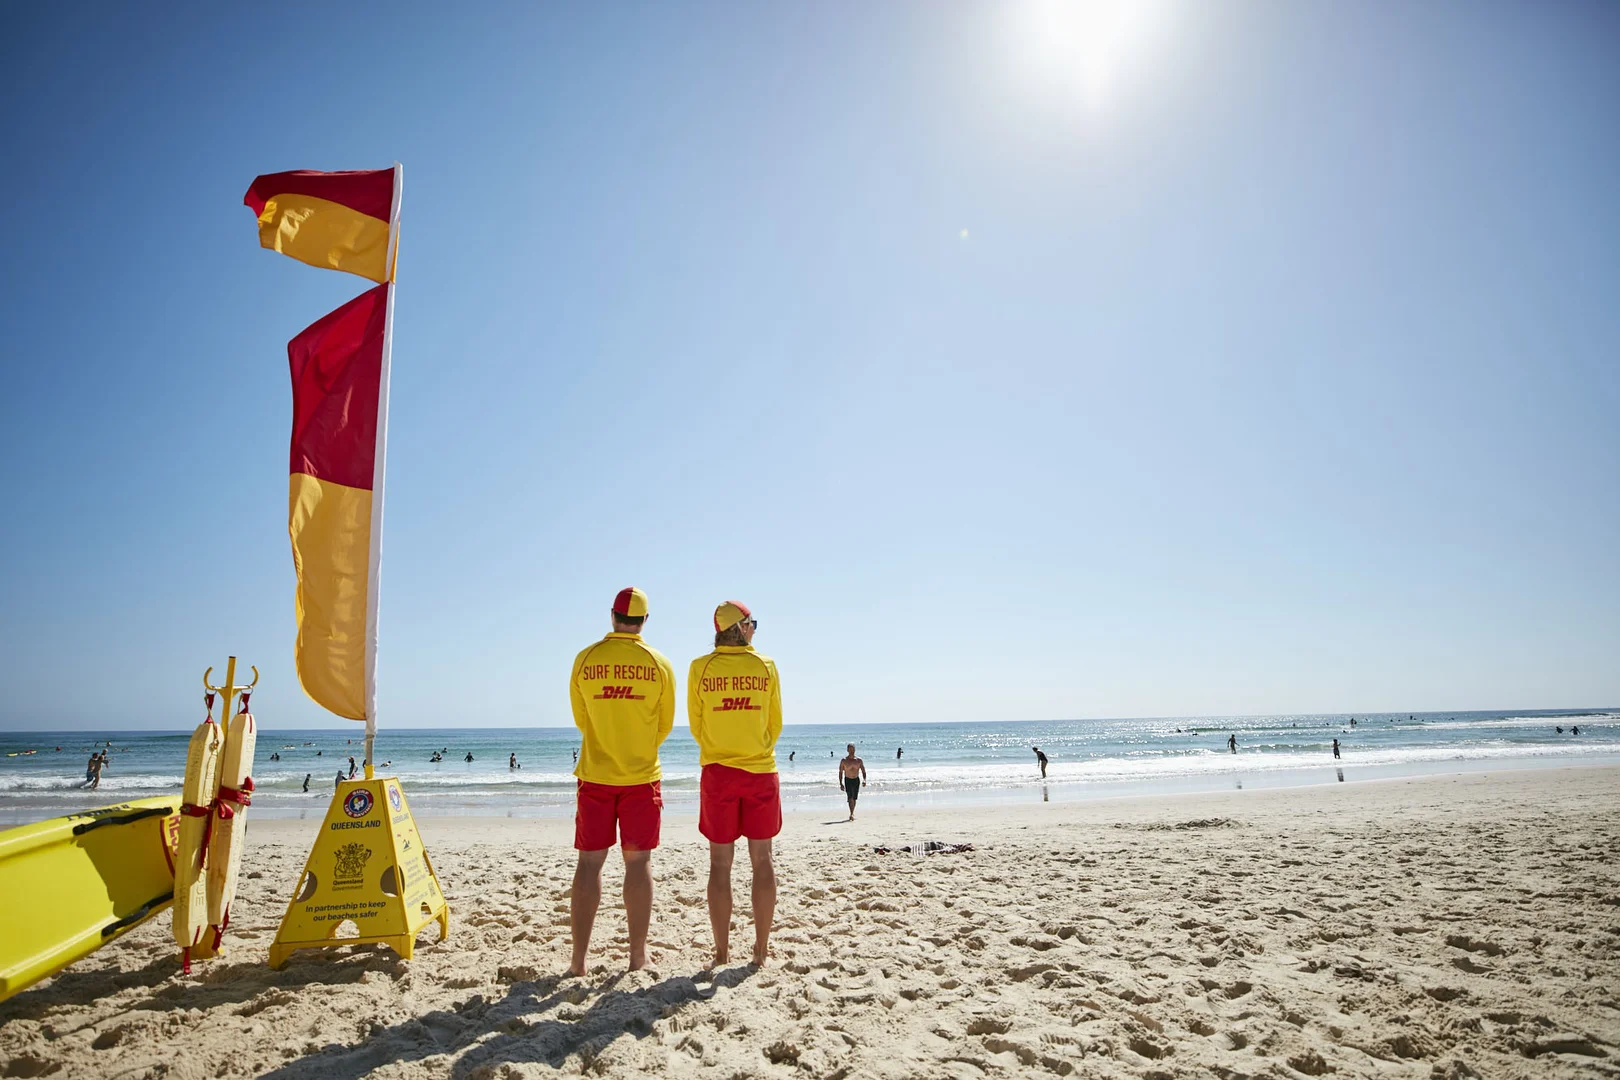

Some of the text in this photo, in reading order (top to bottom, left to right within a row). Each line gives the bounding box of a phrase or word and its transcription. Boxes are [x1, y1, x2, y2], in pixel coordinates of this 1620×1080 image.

[583, 664, 656, 682] SURF RESCUE
[702, 675, 769, 692] SURF RESCUE
[602, 685, 633, 699] DHL
[722, 697, 753, 710] DHL
[331, 820, 381, 830] QUEENSLAND
[314, 902, 358, 913] partnership
[368, 901, 386, 909] keep
[327, 912, 358, 920] beaches
